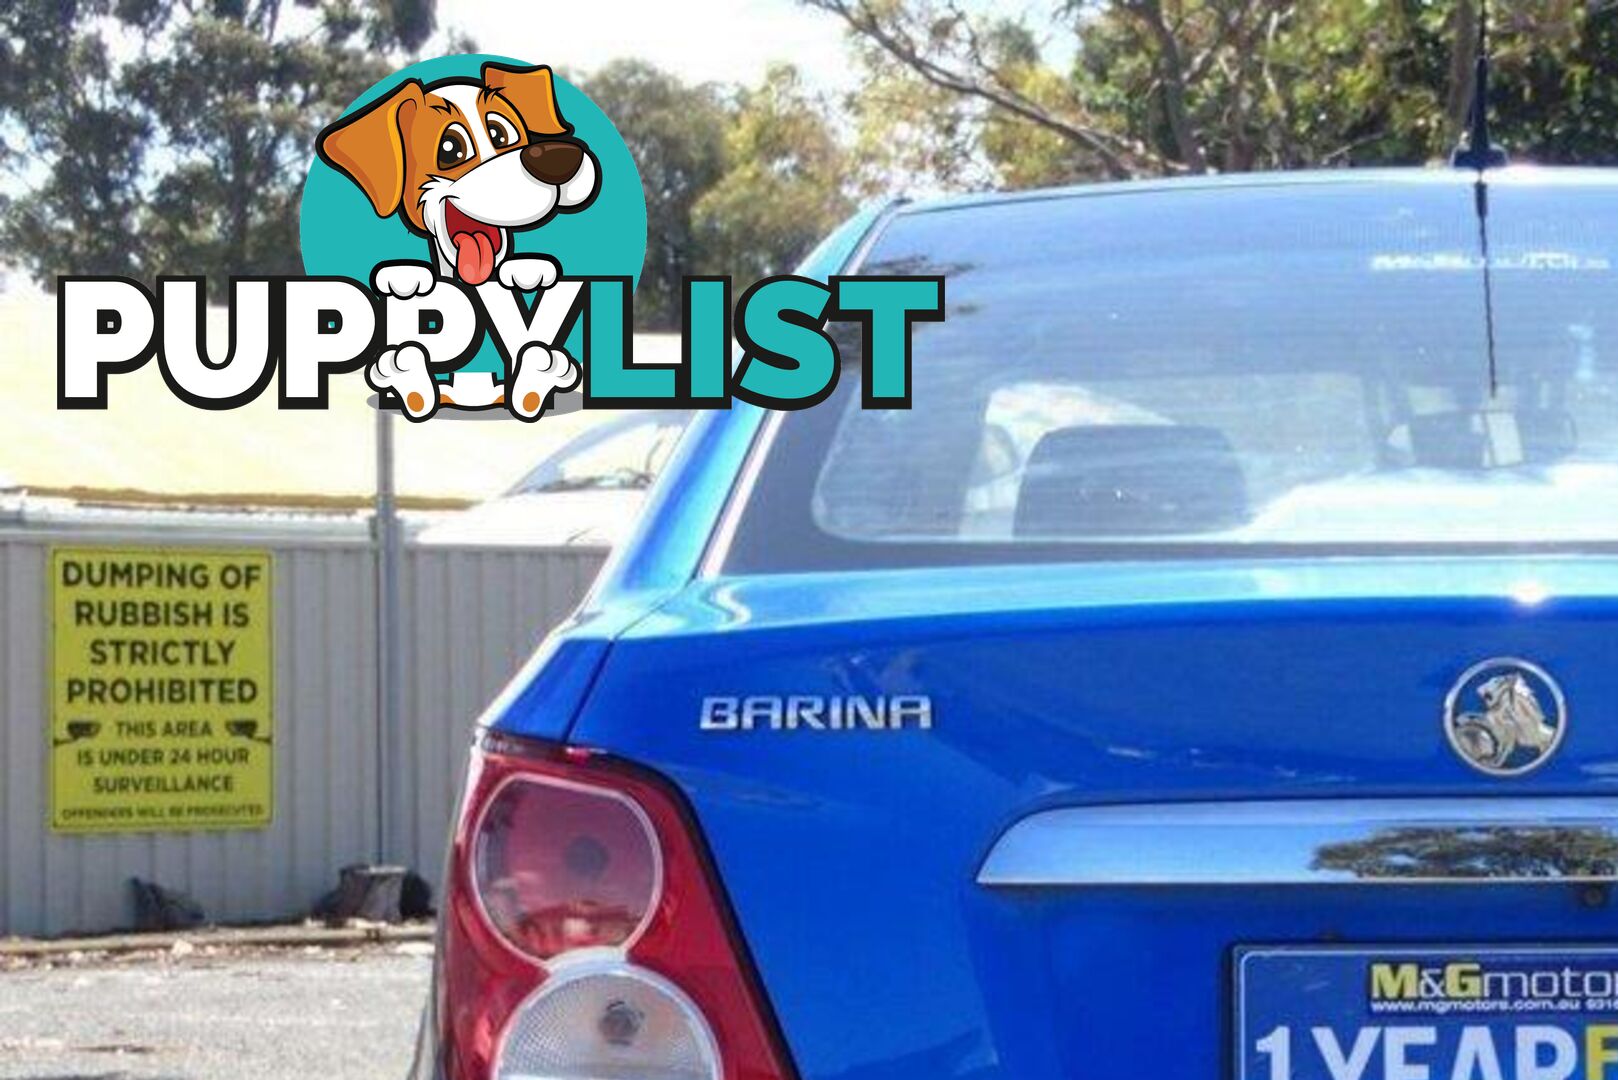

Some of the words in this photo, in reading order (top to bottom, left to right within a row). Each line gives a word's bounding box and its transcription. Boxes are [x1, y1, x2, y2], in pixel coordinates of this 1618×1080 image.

[62, 561, 210, 589] DUMPING
[219, 564, 261, 590] OF
[75, 601, 212, 626] RUBBISH
[223, 603, 249, 627] IS
[89, 640, 236, 665] STRICTLY
[66, 679, 259, 704] PROHIBITED
[700, 695, 932, 730] BARINA
[116, 721, 157, 737] THIS
[162, 721, 213, 737] AREA
[77, 751, 93, 766] IS
[100, 749, 164, 766] UNDER
[171, 749, 191, 765] 24
[196, 748, 250, 764] HOUR
[93, 776, 234, 793] SURVEILLANCE
[62, 808, 133, 819] OFFENDERS
[137, 807, 164, 817] WILL
[169, 806, 182, 816] BE
[1371, 1000, 1580, 1012] www.mgmotors.com.au
